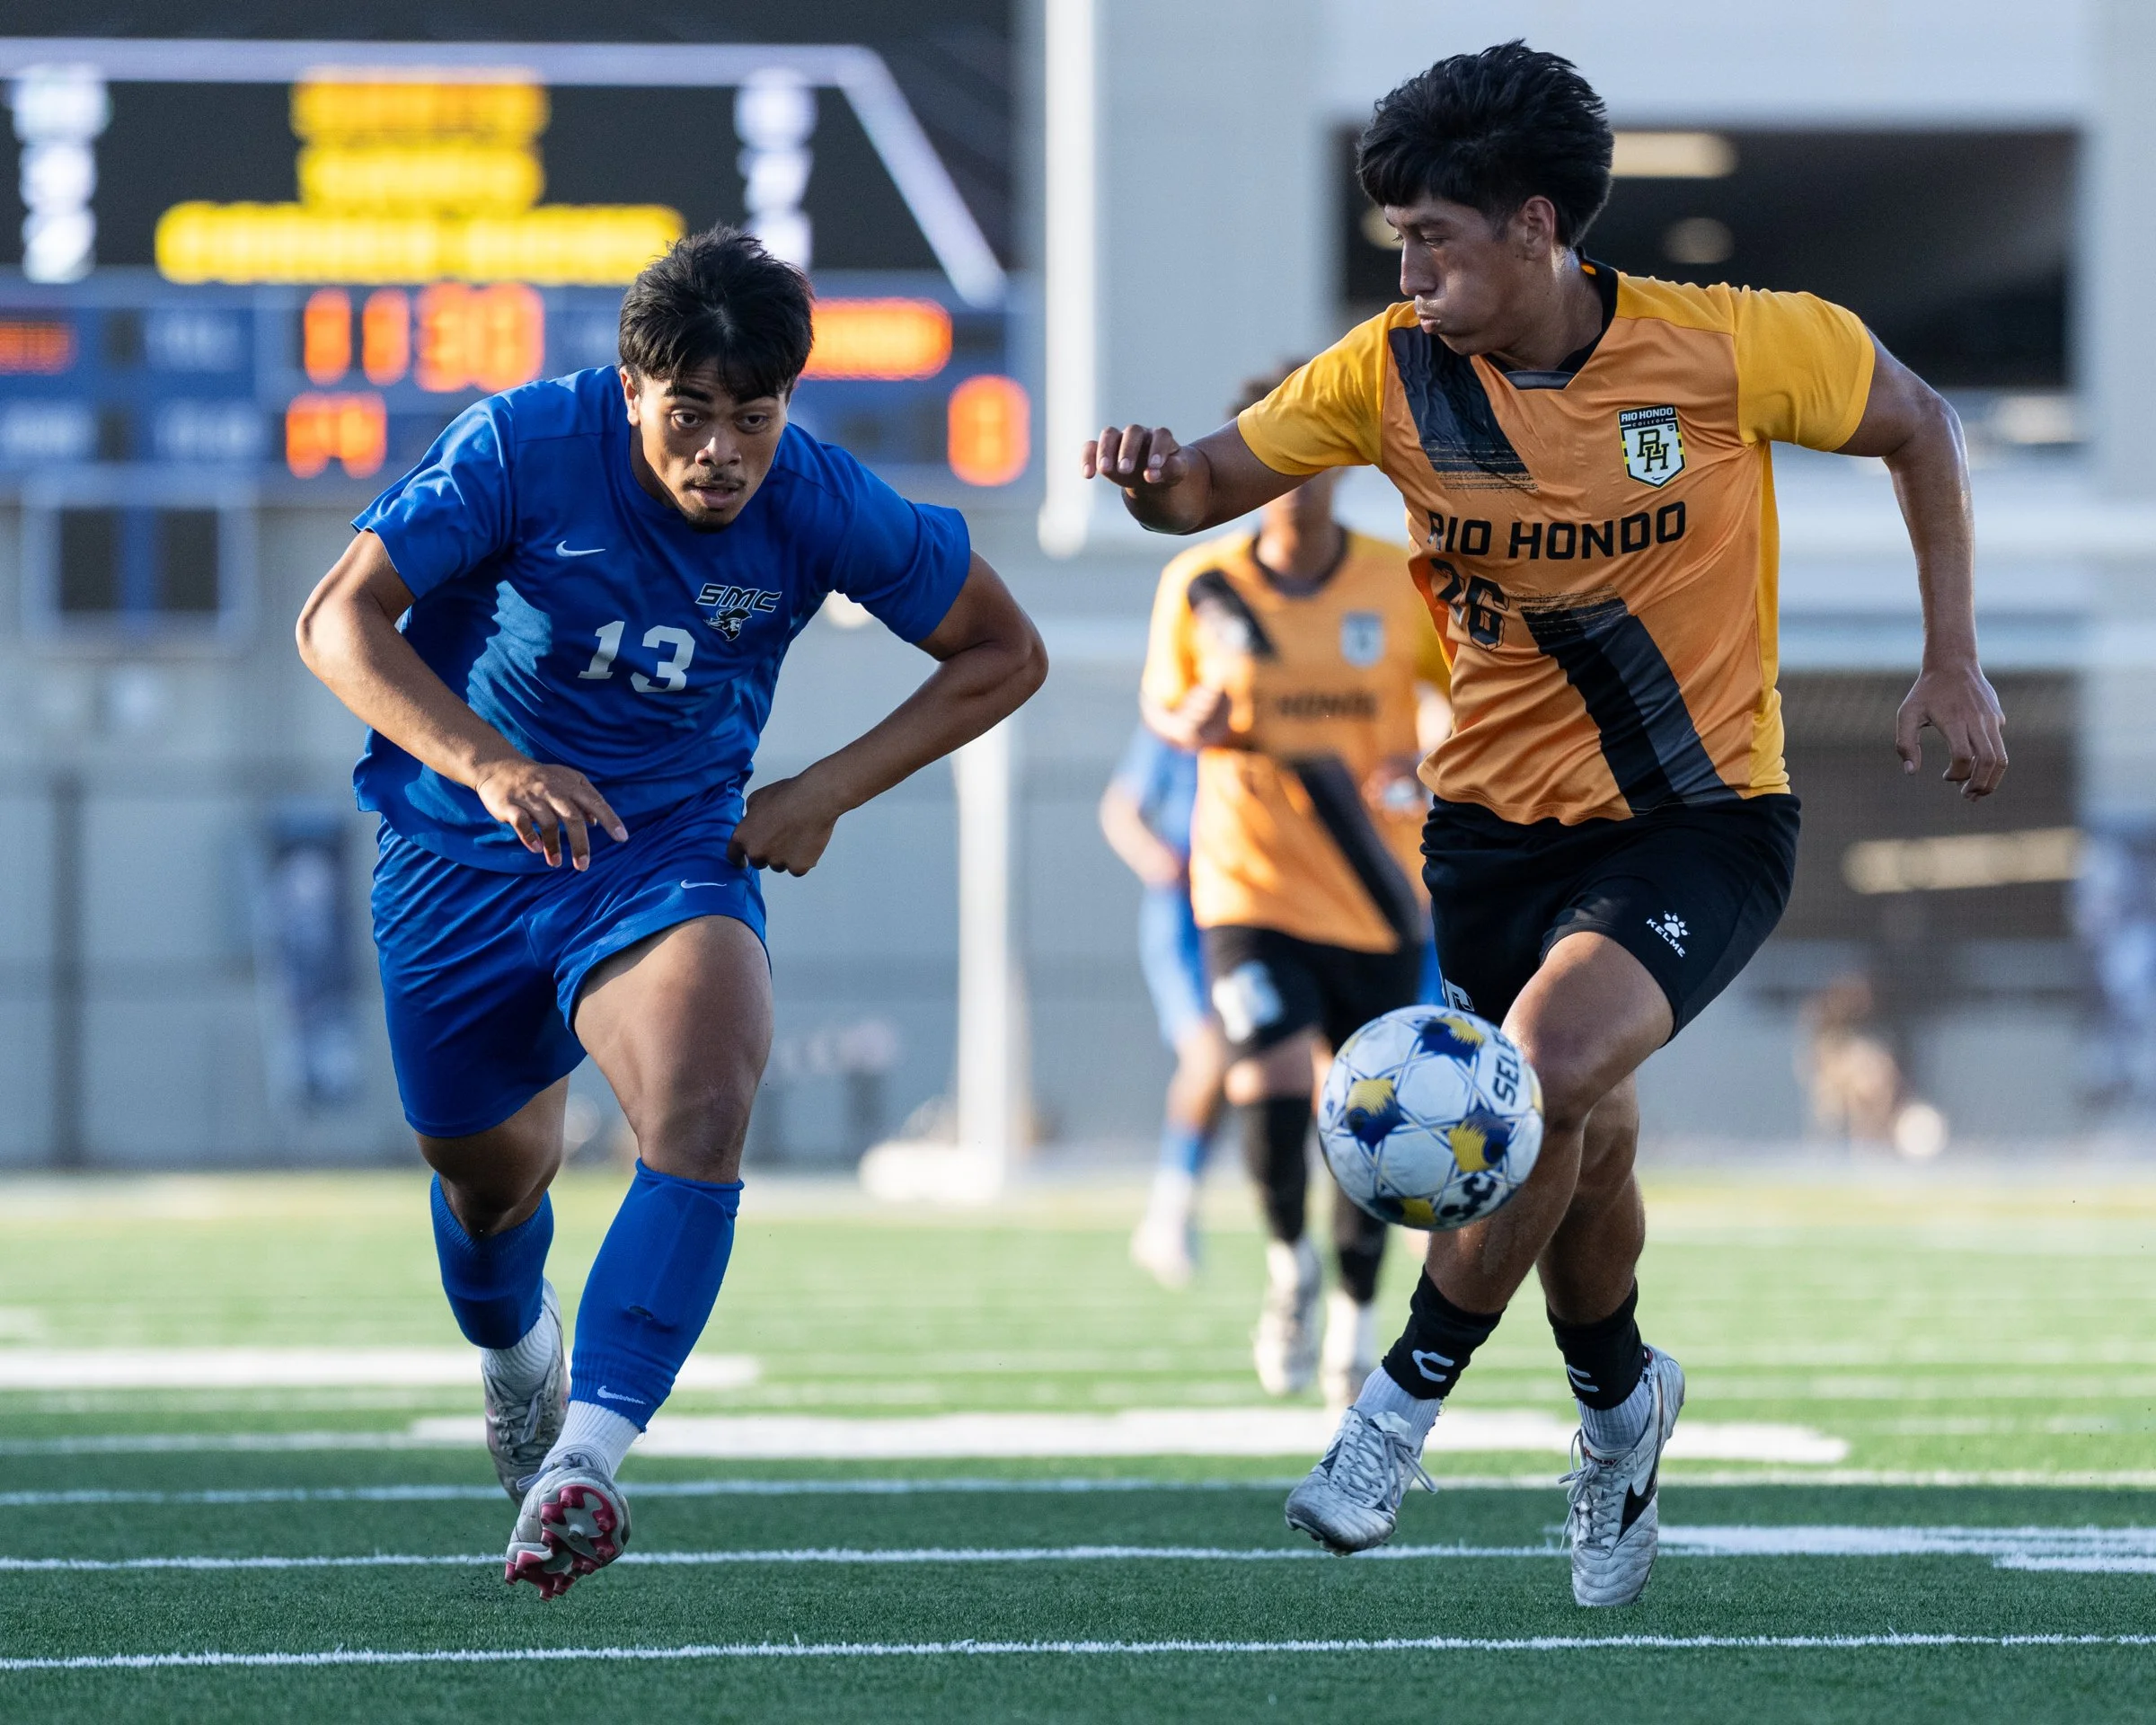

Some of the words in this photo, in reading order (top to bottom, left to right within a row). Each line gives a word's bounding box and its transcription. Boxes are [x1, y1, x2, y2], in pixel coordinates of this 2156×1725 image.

[1621, 411, 1638, 422] RIO
[1639, 407, 1674, 420] HONDO
[1427, 509, 1492, 556] RIO
[1508, 500, 1687, 561] HONDO
[694, 582, 782, 613] SMC
[577, 620, 696, 694] 13
[1646, 918, 1685, 958] KELME
